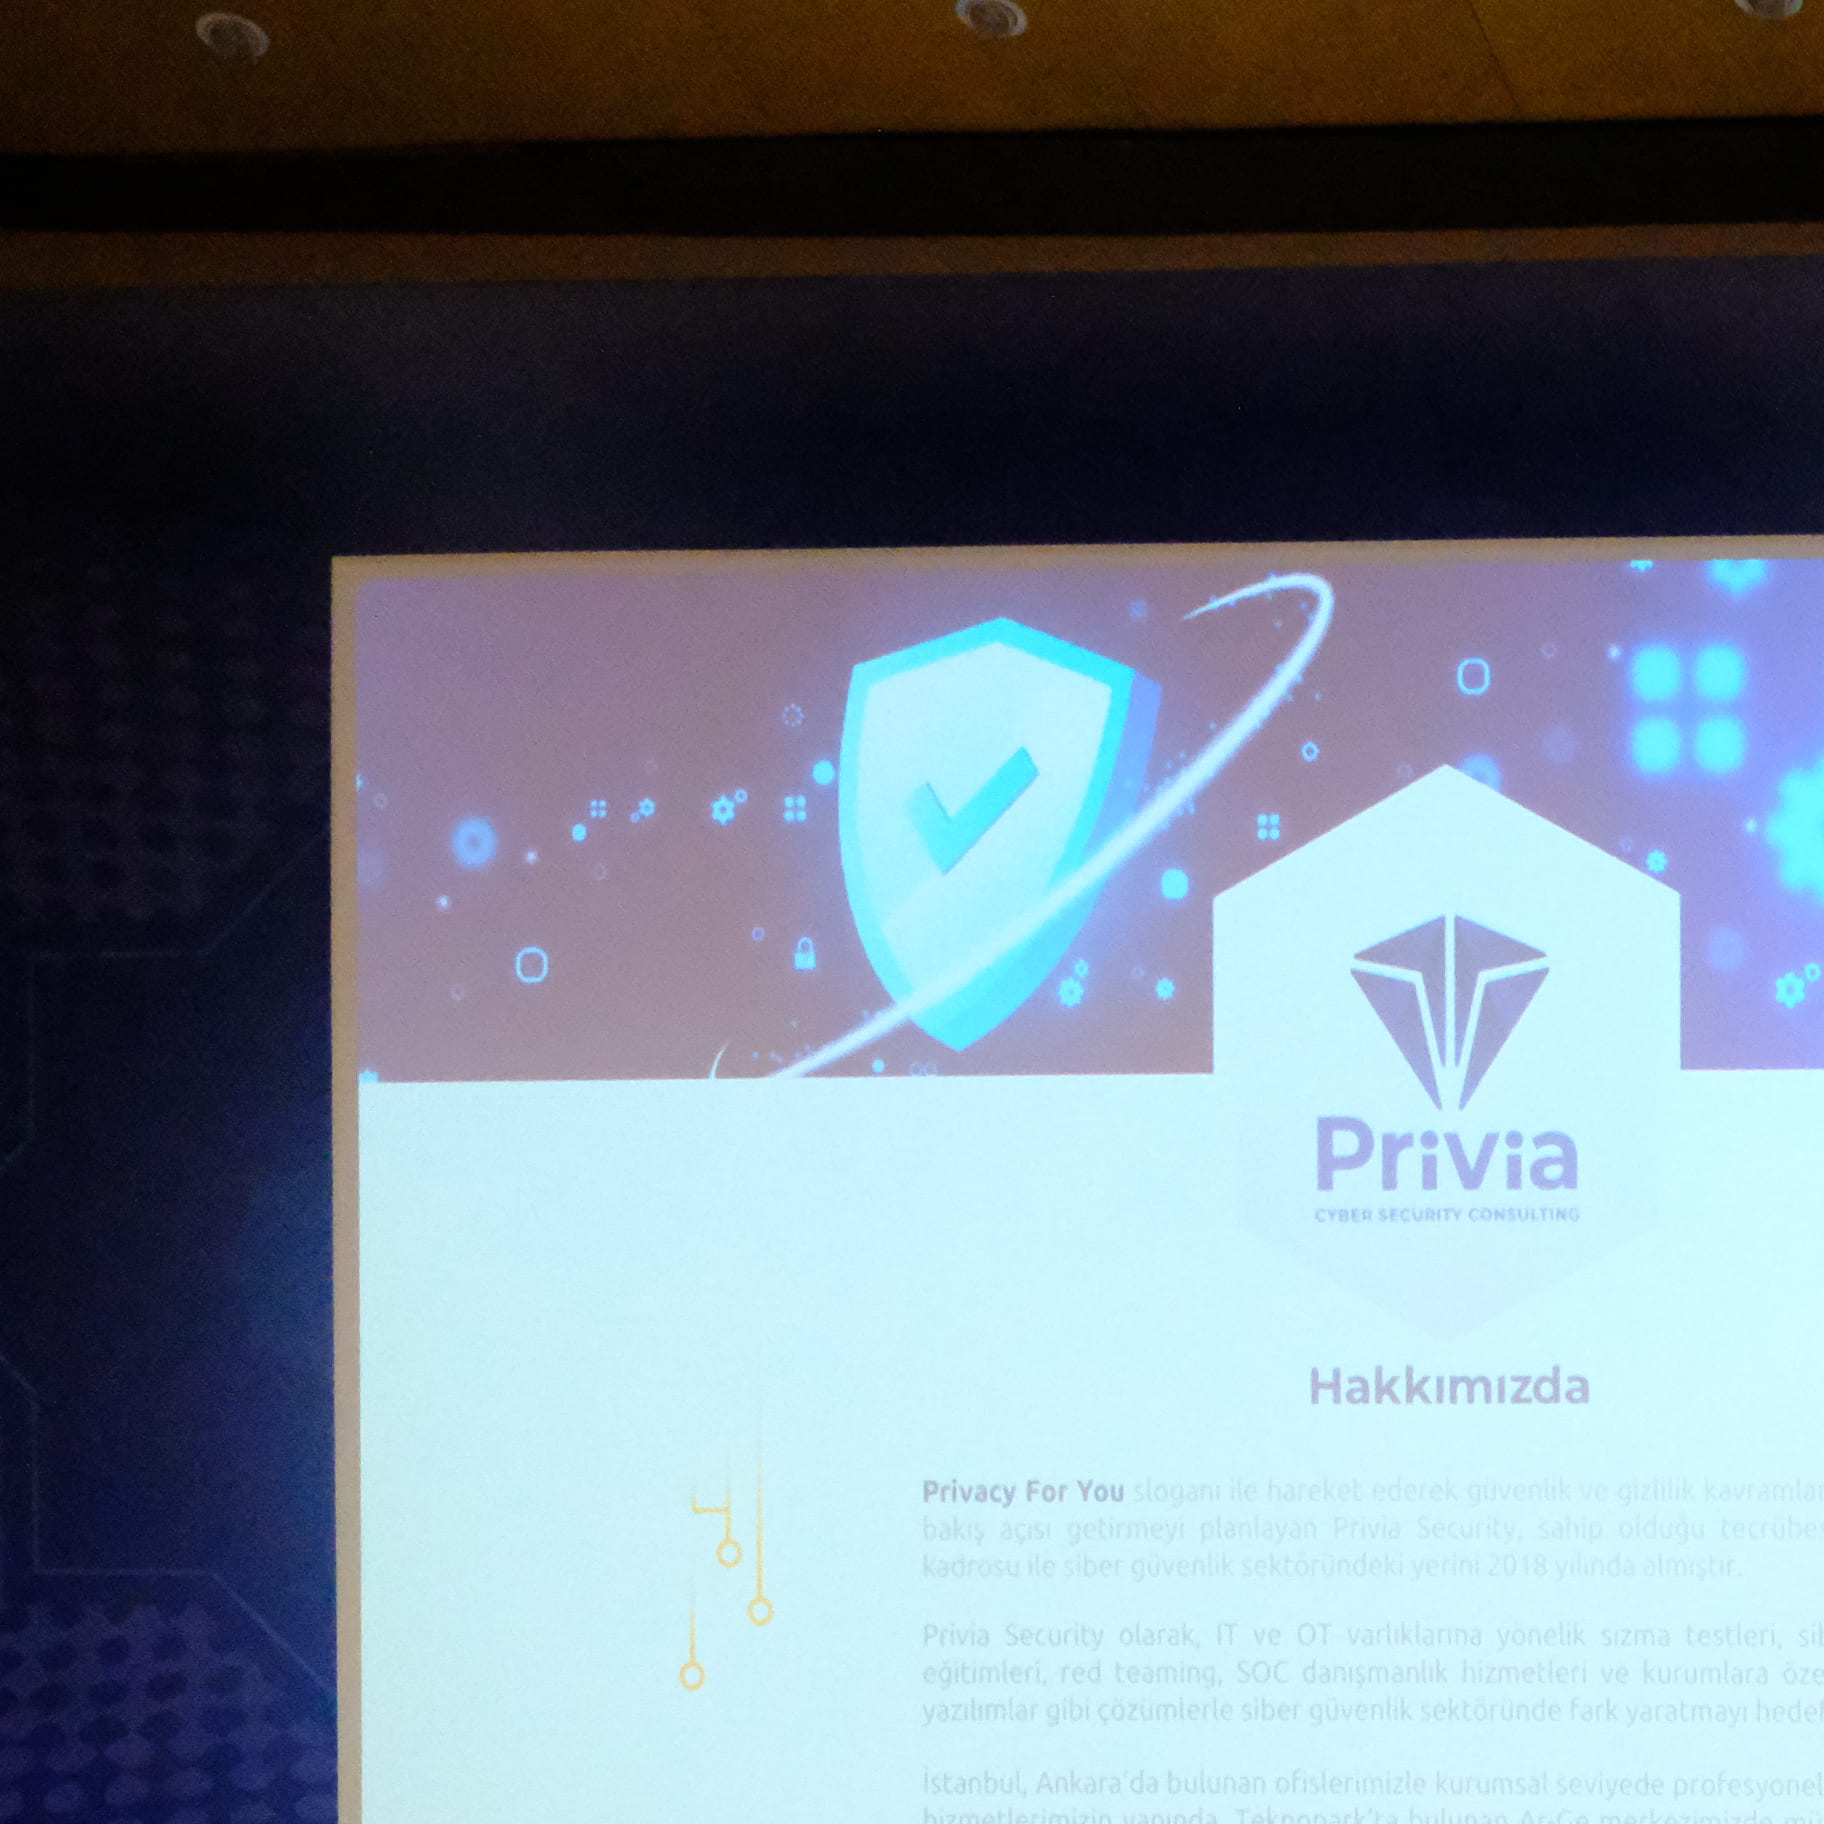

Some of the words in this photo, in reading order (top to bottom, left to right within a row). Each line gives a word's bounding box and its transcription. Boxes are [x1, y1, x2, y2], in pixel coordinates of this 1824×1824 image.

[1316, 1114, 1579, 1192] Privia
[1314, 1207, 1373, 1224] CYBER
[1378, 1207, 1462, 1224] SECURITY
[1468, 1206, 1581, 1223] CONSULTING
[1307, 1364, 1592, 1407] Hakkımızda
[921, 1474, 1019, 1509] Privacy
[1024, 1474, 1071, 1502] For
[1074, 1474, 1126, 1502] You
[921, 1620, 992, 1648] Privia
[1003, 1620, 1105, 1655] Security
[1117, 1620, 1202, 1651] olarak,
[1215, 1620, 1240, 1648] IT
[1252, 1628, 1283, 1648] ve
[1295, 1620, 1333, 1648] OT
[1346, 1620, 1483, 1648] varlıklarına
[1495, 1620, 1587, 1655] yönelik
[1599, 1628, 1672, 1648] sızma
[1684, 1620, 1783, 1651] testleri,
[921, 1762, 1029, 1797] İstanbul,
[1034, 1767, 1160, 1795] Ankara'da
[1165, 1767, 1268, 1795] bulunan
[1273, 1768, 1428, 1796] ofislerimizle
[1434, 1768, 1549, 1796] kurumsal
[1555, 1769, 1665, 1804] seviyede
[1671, 1770, 1824, 1805] profesyonel
